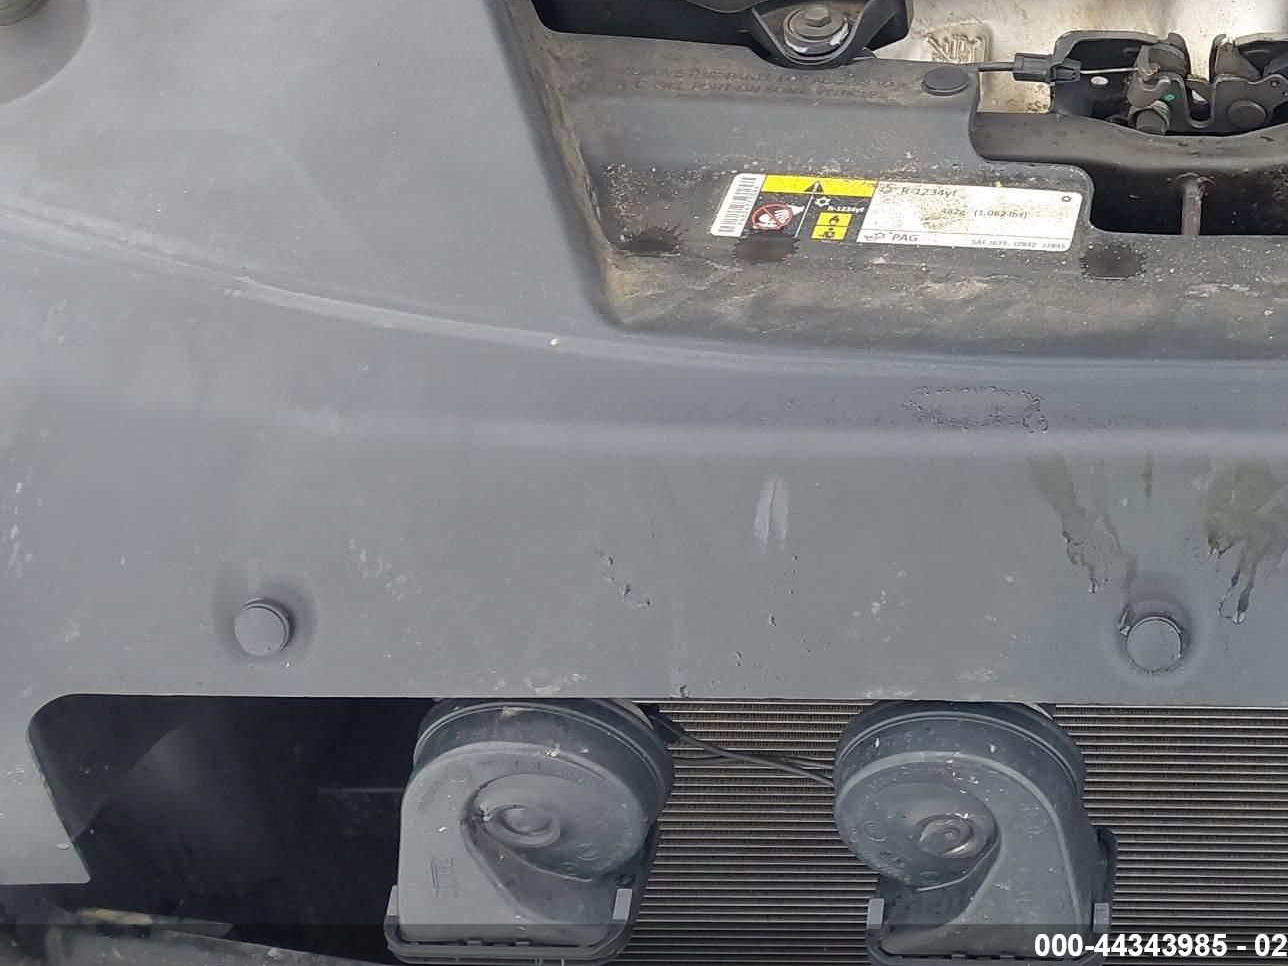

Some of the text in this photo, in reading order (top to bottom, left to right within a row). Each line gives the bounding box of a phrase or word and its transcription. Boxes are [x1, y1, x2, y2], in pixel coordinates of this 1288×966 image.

[900, 188, 959, 198] R-1234yf
[827, 205, 865, 214] R-1234yf
[892, 233, 919, 242] PAG
